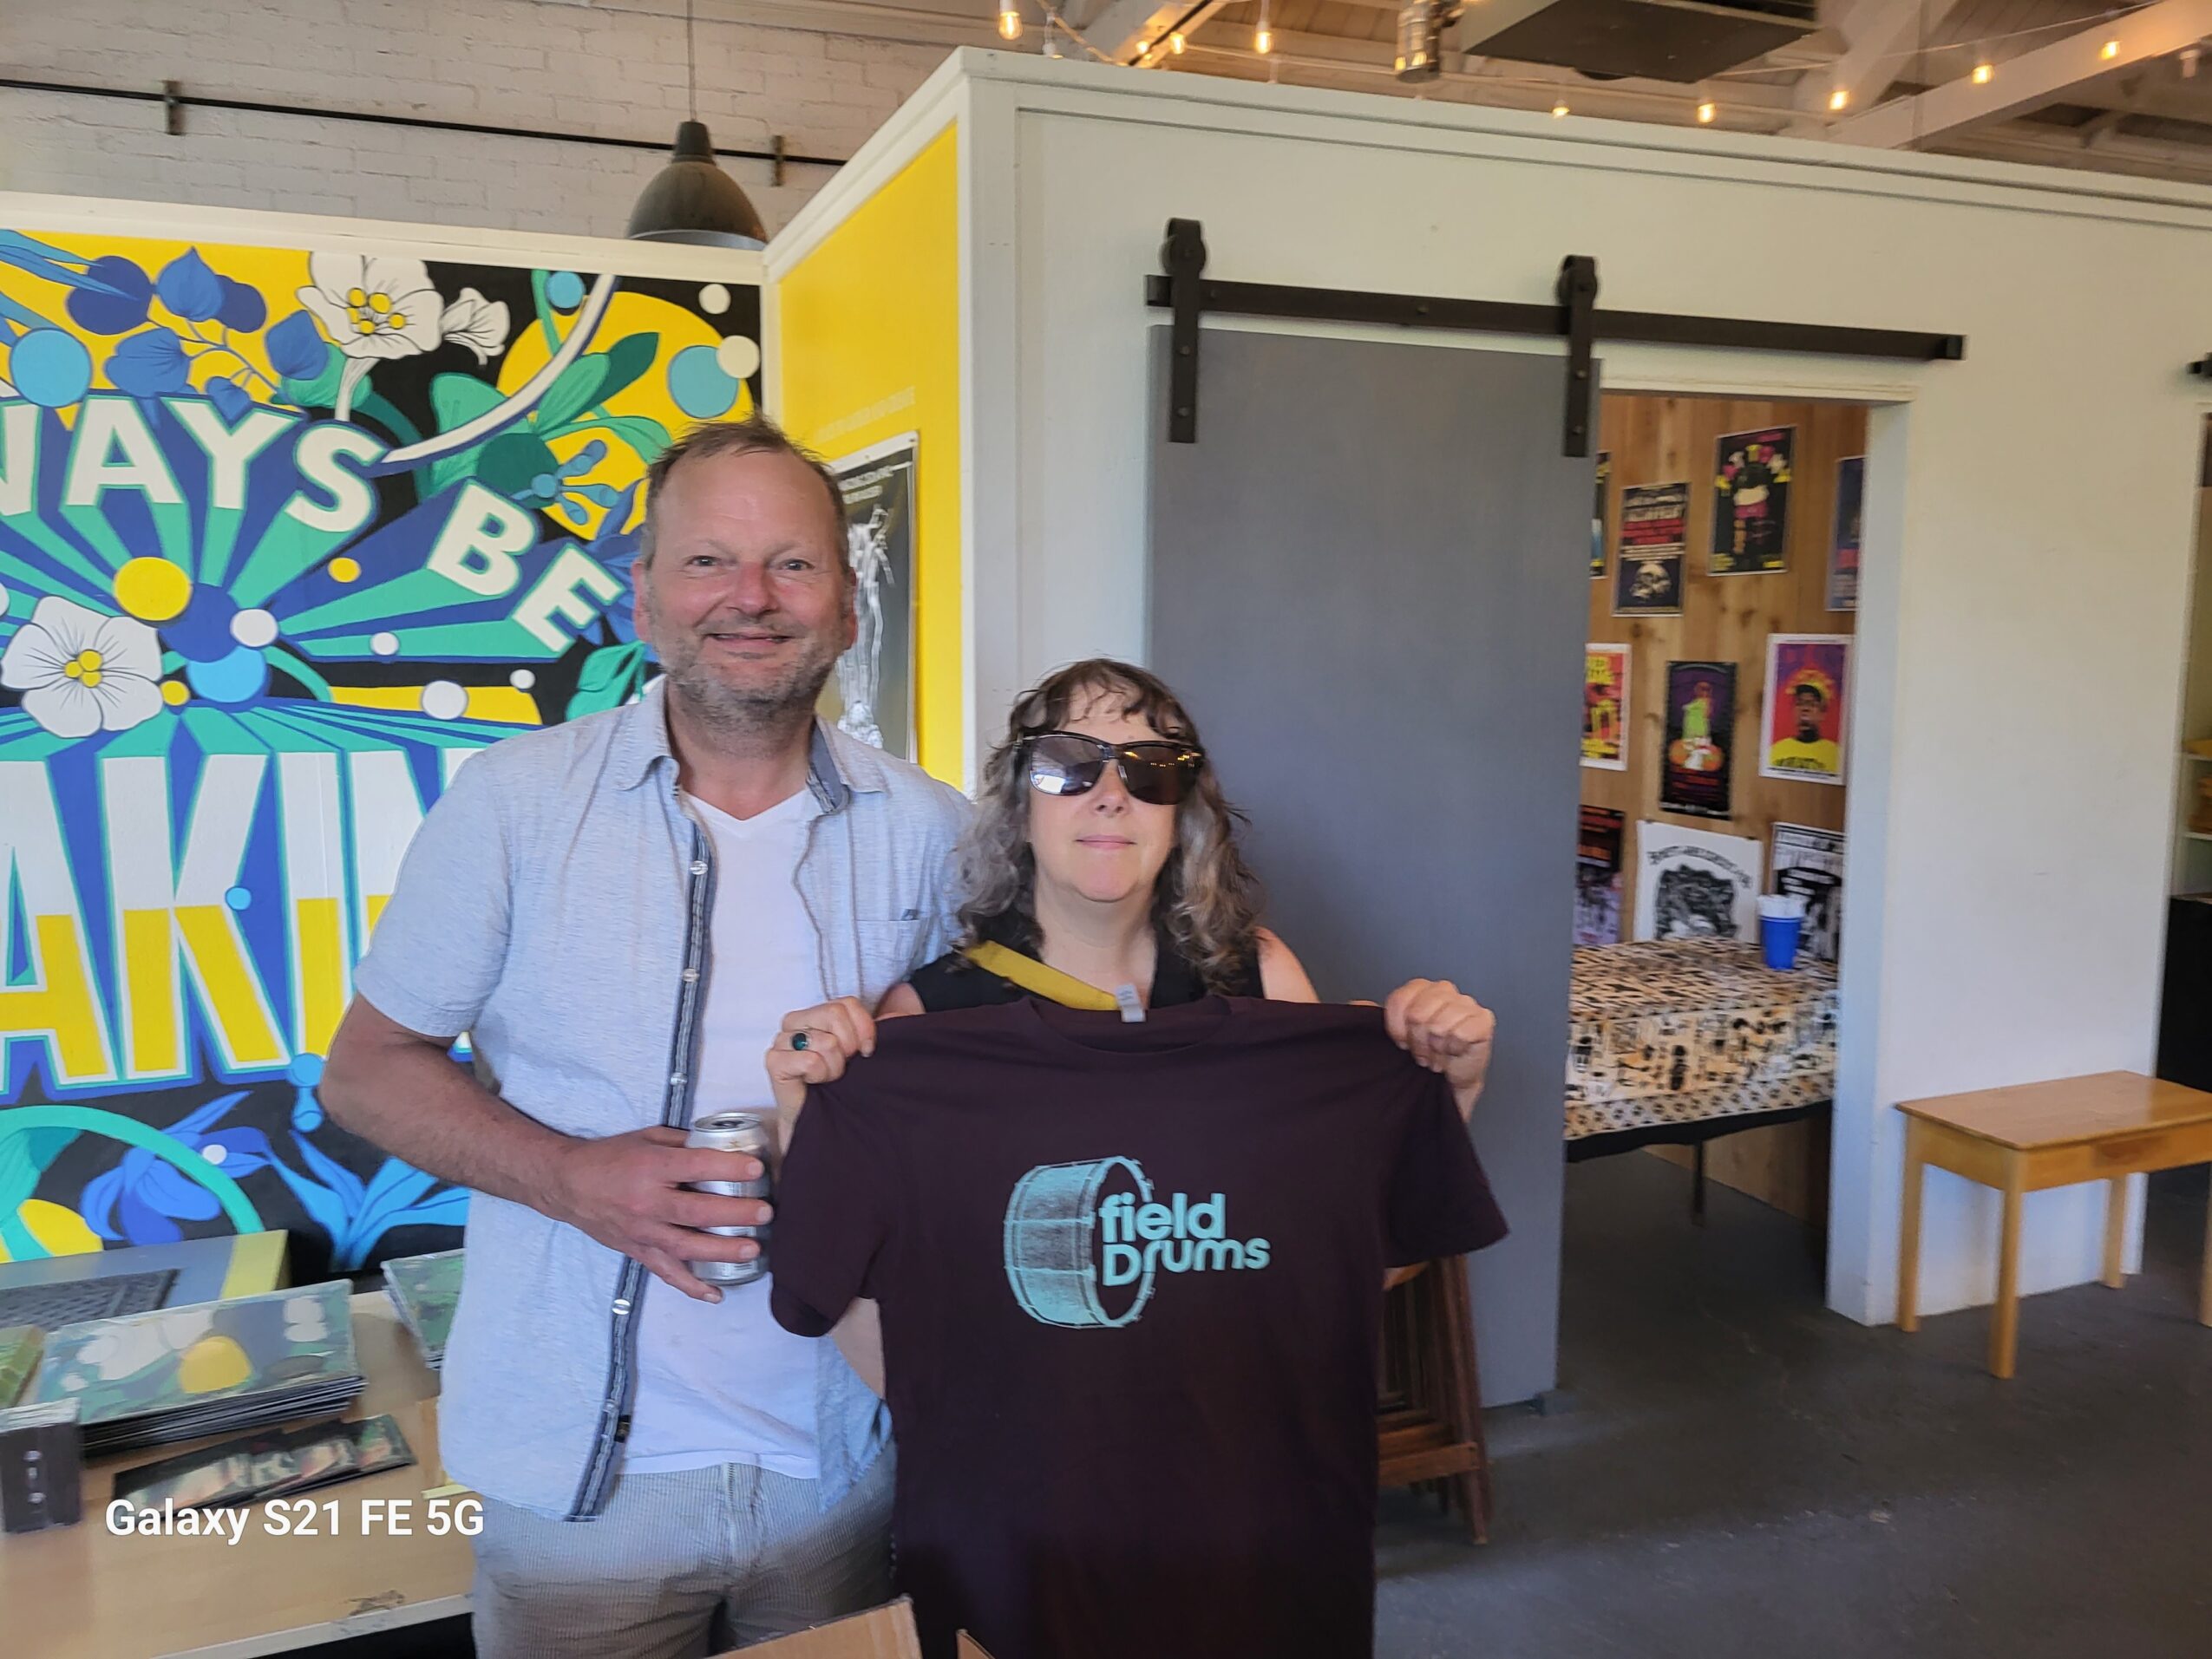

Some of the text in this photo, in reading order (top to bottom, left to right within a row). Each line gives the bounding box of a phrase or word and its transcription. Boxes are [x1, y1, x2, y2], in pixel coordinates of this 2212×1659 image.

[0, 398, 623, 653] AYS BE
[1098, 1192, 1226, 1244] field
[1103, 1238, 1271, 1286] Drums
